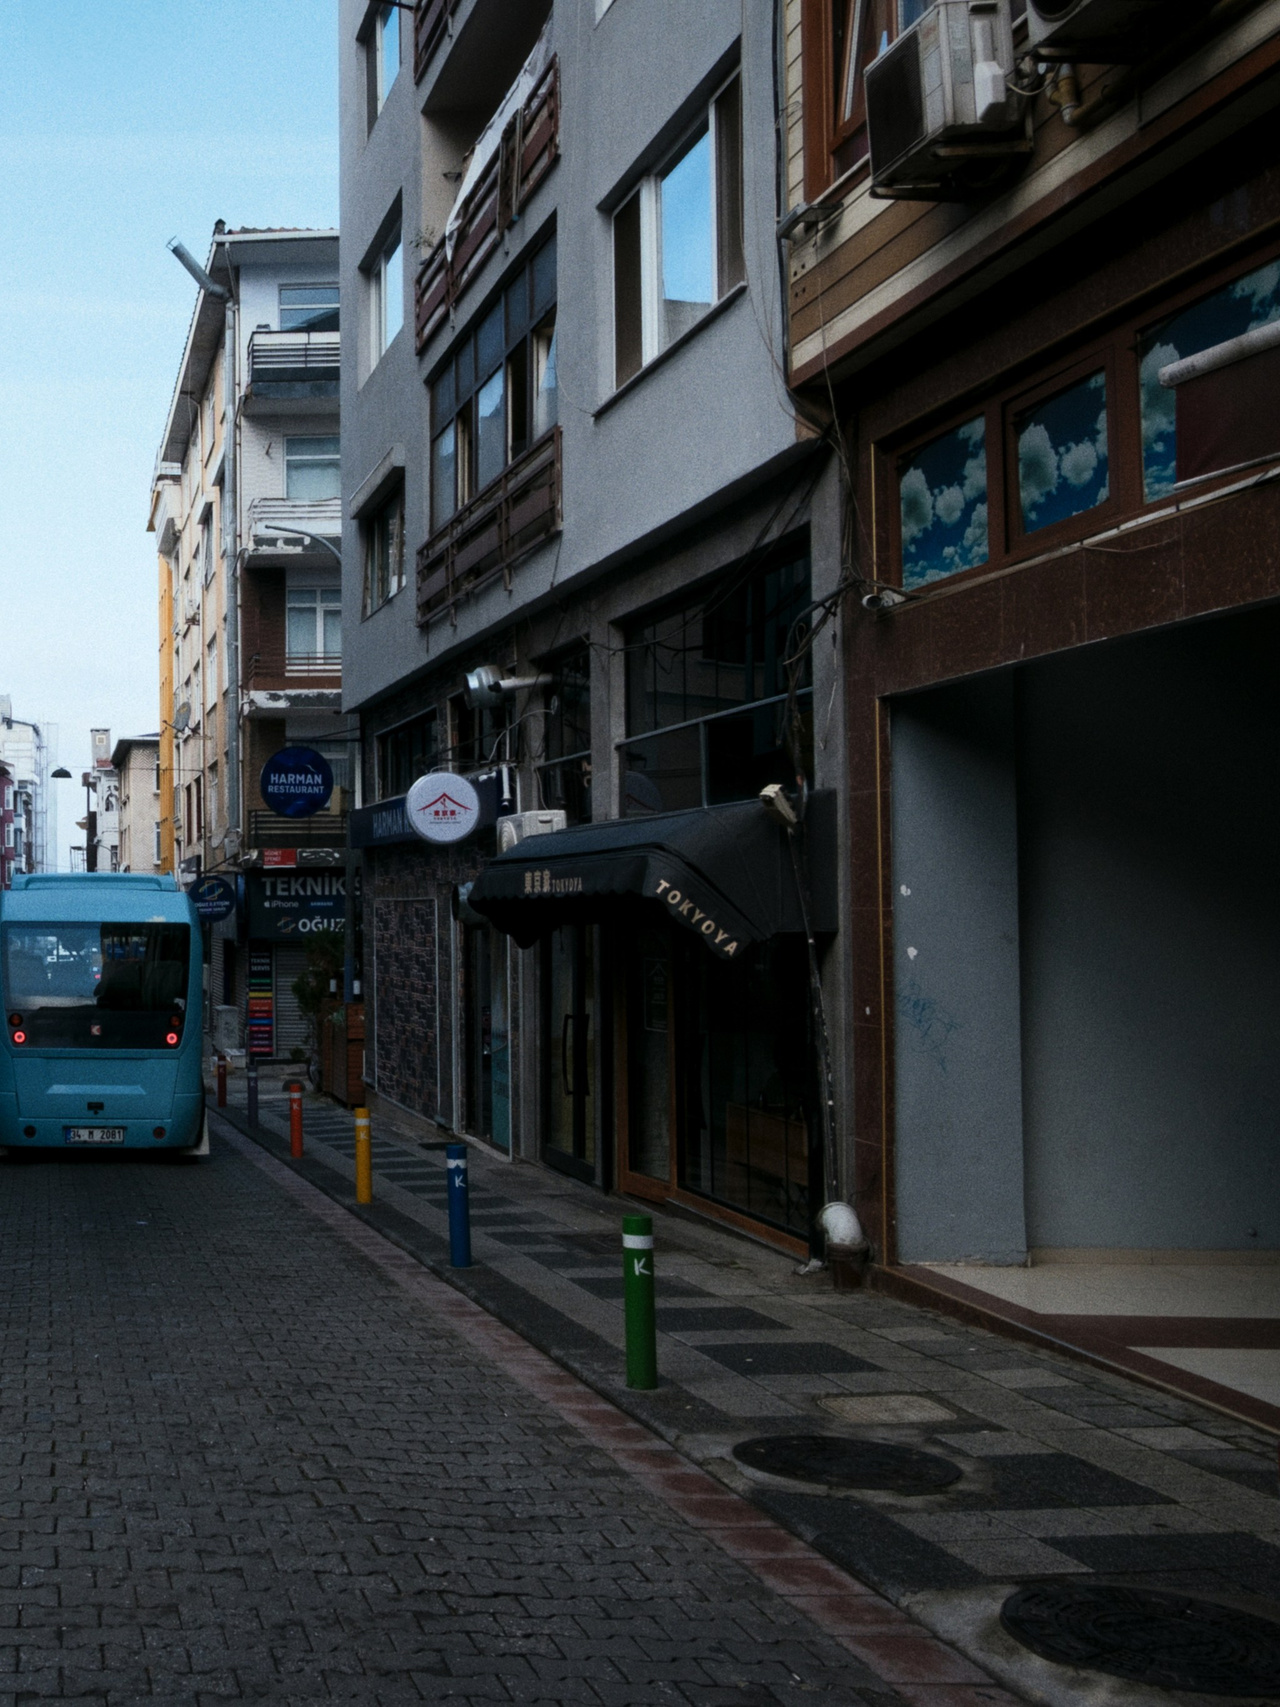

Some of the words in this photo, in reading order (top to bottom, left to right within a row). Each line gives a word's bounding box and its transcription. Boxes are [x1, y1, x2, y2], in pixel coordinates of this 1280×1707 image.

[270, 773, 323, 785] HARMAN
[267, 785, 325, 794] RESTAURANT
[261, 872, 347, 896] TEKNİK
[552, 877, 583, 893] TOKYOYA
[298, 915, 346, 933] OĞUZ
[655, 878, 739, 957] TOKYOYA
[71, 1130, 81, 1139] 34
[88, 1130, 94, 1139] M
[100, 1130, 121, 1140] 2081
[359, 1130, 368, 1140] K
[454, 1174, 466, 1188] K
[633, 1256, 651, 1276] K
